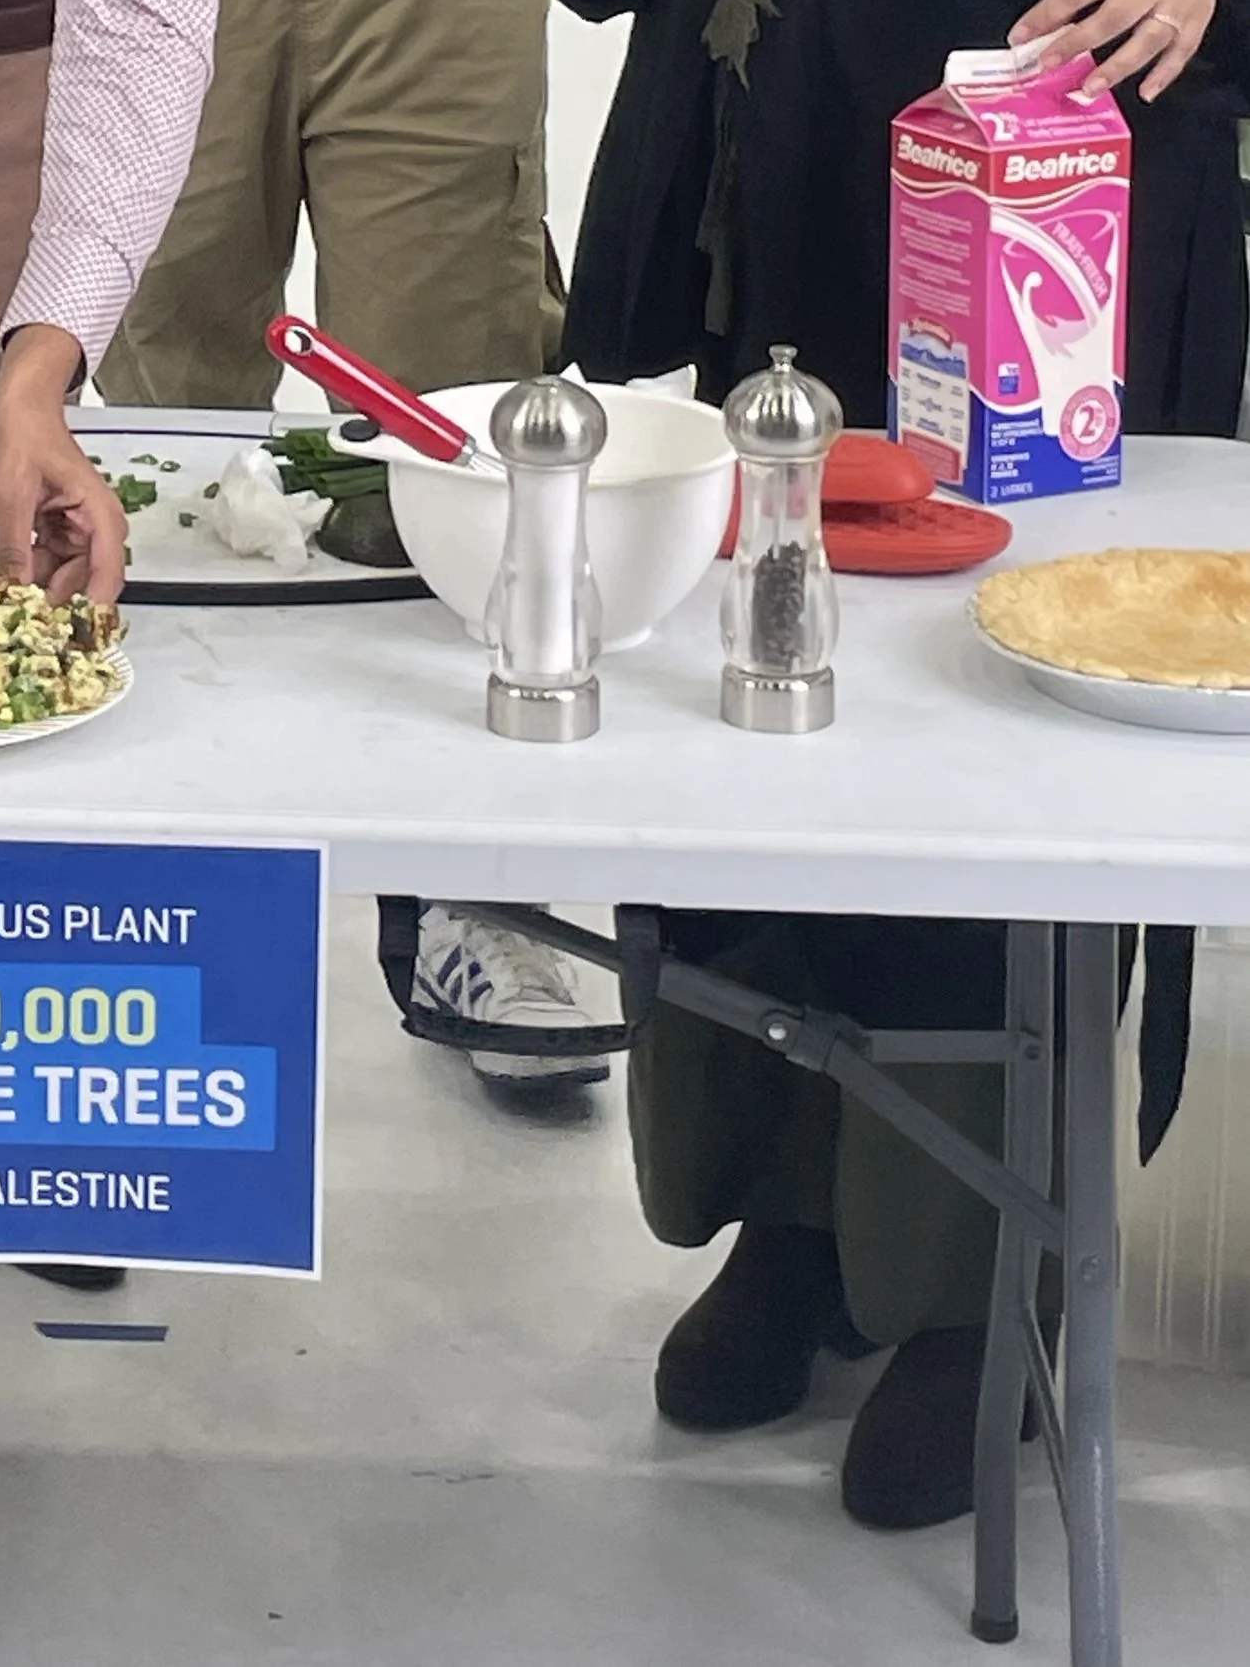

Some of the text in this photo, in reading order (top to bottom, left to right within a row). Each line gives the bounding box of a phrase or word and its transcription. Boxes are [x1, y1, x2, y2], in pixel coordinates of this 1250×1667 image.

[896, 133, 979, 181] Beatrice
[1003, 149, 1118, 183] Beatrice
[63, 904, 198, 945] PLANT
[32, 1065, 247, 1128] TREES
